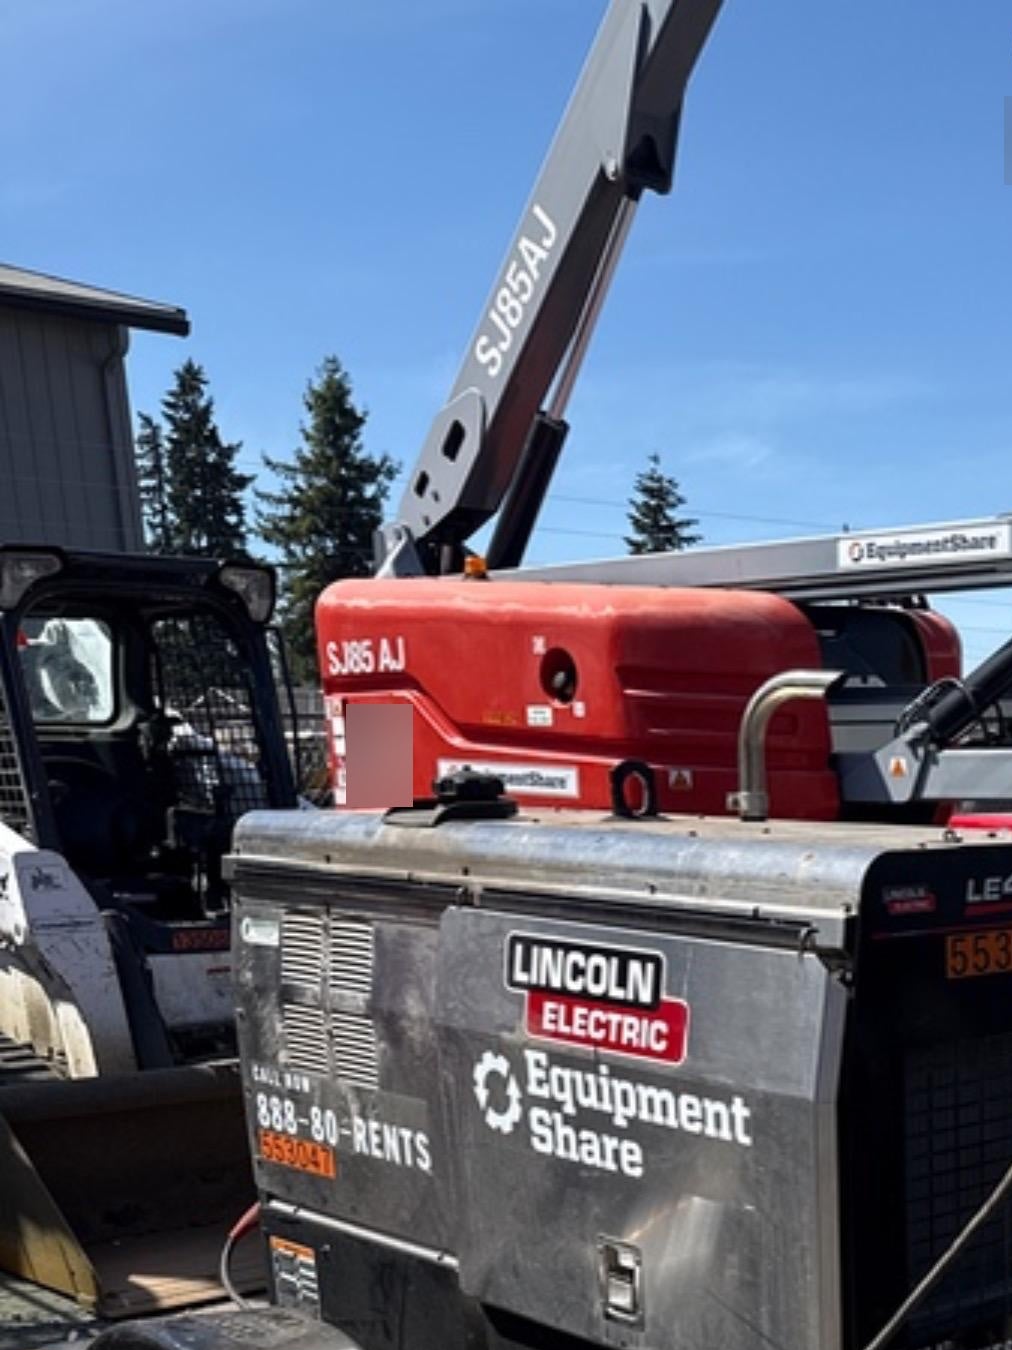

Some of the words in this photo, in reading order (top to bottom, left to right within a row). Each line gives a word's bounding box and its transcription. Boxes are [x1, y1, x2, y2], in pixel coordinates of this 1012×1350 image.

[475, 203, 558, 378] SJ85AJ
[865, 533, 997, 562] EquipmentShare
[326, 638, 376, 675] SJ85
[378, 636, 406, 673] AJ
[512, 943, 655, 1003] LINCOLN
[541, 1000, 668, 1051] ELECTRIC
[524, 1049, 752, 1147] Equipment
[256, 1092, 433, 1171] 888-80-RENTS
[529, 1106, 644, 1178] Share
